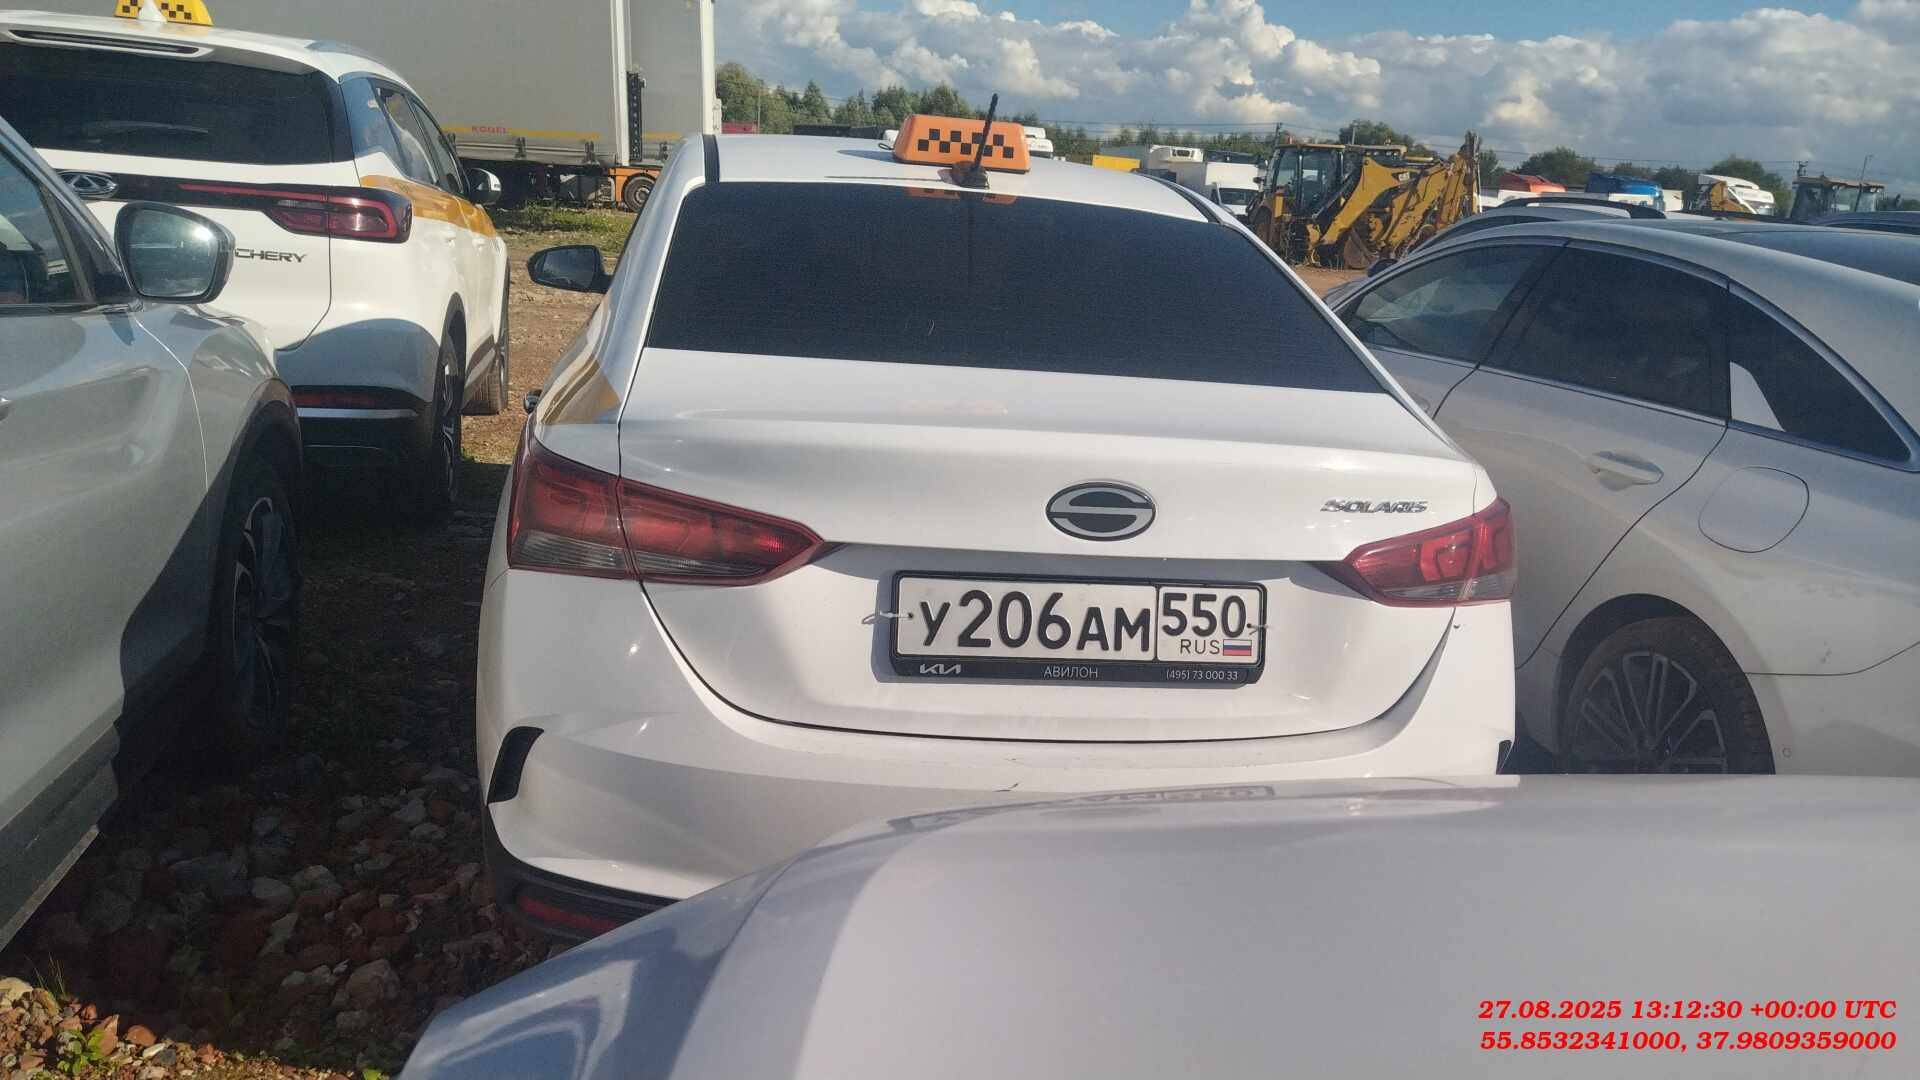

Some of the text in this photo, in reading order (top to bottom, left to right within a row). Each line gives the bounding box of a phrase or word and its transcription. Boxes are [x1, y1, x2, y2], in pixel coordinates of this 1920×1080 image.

[235, 248, 307, 263] CHERY
[1320, 499, 1428, 514] SOLARIS
[1162, 592, 1247, 639] 550
[1179, 638, 1220, 656] RUS
[919, 663, 961, 674] KIA
[1043, 666, 1099, 679] АВИЛОН
[1166, 669, 1238, 681] (495) 73 000 33
